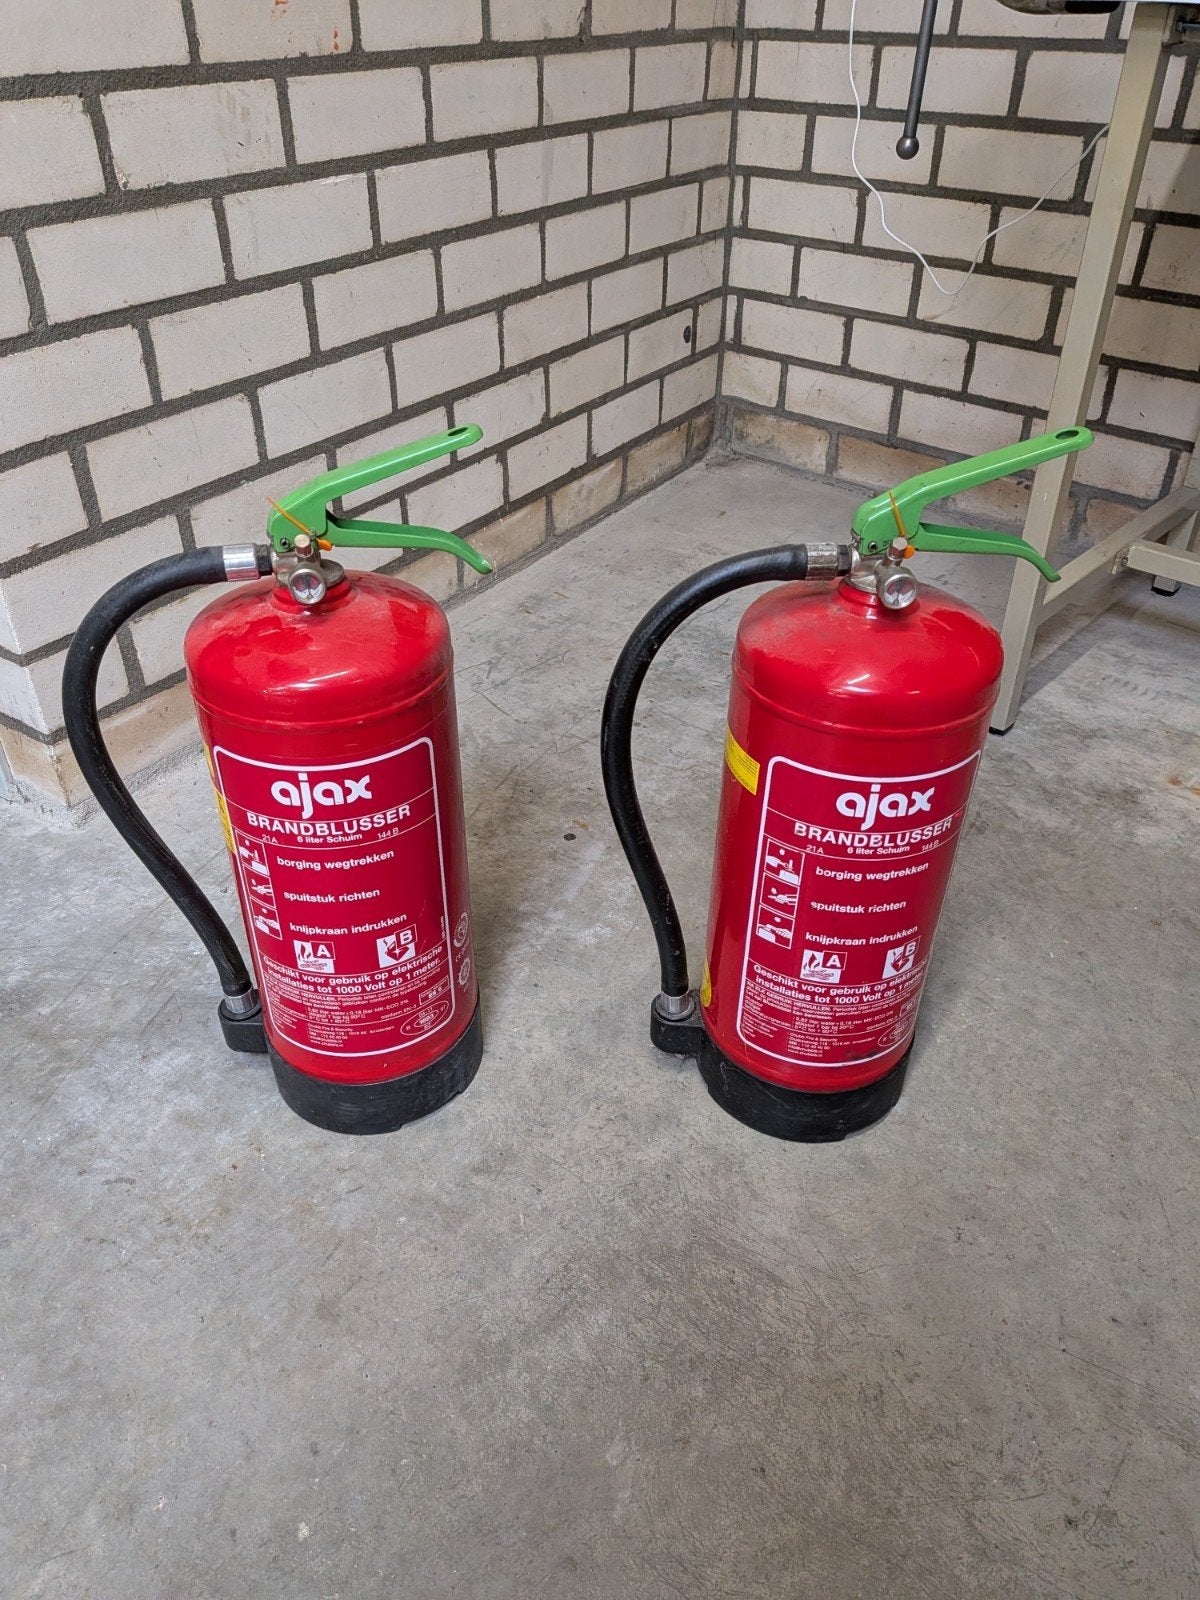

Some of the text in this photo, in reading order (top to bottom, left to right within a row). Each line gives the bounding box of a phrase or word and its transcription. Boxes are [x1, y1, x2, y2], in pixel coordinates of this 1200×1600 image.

[271, 772, 372, 820] ajax
[836, 783, 935, 831] ajax
[246, 804, 411, 836] BRANDBLUSSER
[297, 833, 363, 844] 6 liter Schuim
[794, 817, 953, 848] BRANDBLUSSER
[856, 846, 875, 855] liter
[876, 845, 910, 855] Schuim
[276, 850, 395, 871] borging wegtrekken
[816, 862, 929, 882] borging wegtrekken
[284, 889, 380, 903] spuitstuk richten
[810, 900, 906, 914] spuitstuk richten
[289, 913, 407, 936] knijpkraan indrukken
[400, 929, 413, 945] B
[805, 926, 918, 946] knijpkraan indrukken
[316, 944, 332, 958] A
[904, 941, 917, 957] B
[263, 956, 300, 980] Geschikt
[302, 974, 326, 984] voor
[329, 975, 371, 986] gebruik
[374, 972, 389, 981] op
[392, 946, 443, 976] elektrische
[826, 954, 842, 968] A
[317, 985, 332, 994] tot
[336, 985, 362, 994] 1000
[364, 982, 386, 992] Volt
[389, 976, 403, 986] op
[406, 973, 412, 981] 1
[413, 958, 441, 978] meter.
[754, 964, 798, 988] Geschikt
[801, 984, 827, 994] voor
[830, 985, 871, 996] gebruik
[874, 982, 888, 993] op
[756, 976, 811, 1002] installaties
[814, 995, 830, 1004] tot
[834, 996, 859, 1004] 1000
[863, 993, 882, 1003] Volt
[884, 988, 896, 998] op
